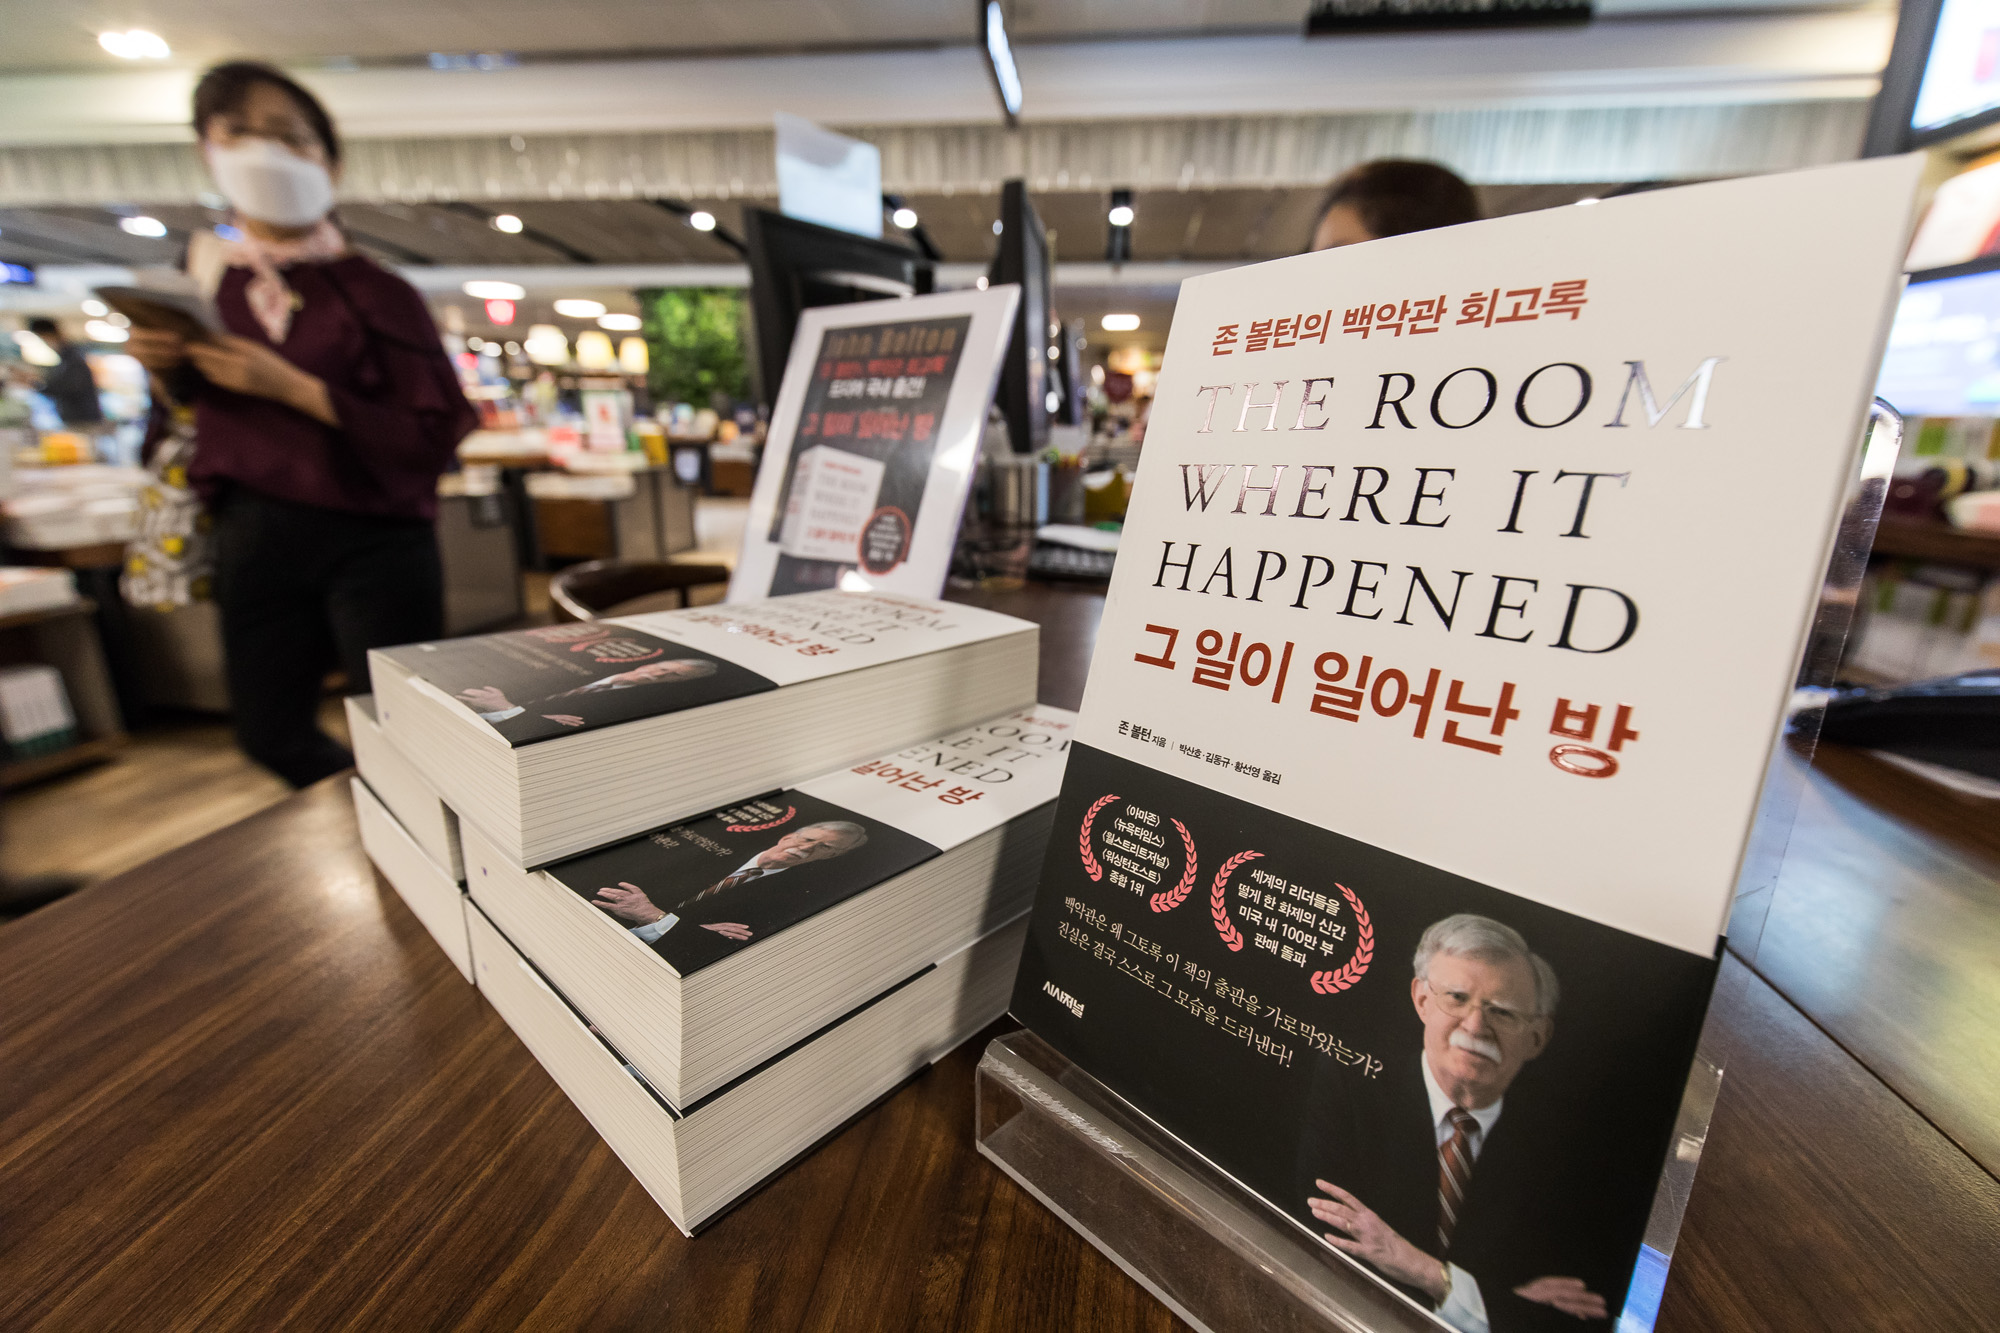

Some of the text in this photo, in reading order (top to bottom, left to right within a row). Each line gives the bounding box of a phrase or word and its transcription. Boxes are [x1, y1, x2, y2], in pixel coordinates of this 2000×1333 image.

[1212, 278, 1589, 356] 존 볼턴의 백악관 회고록
[1196, 356, 1731, 434] THE ROOM
[1178, 464, 1632, 539] WHERE IT
[1152, 541, 1641, 655] HAPPENED
[1134, 623, 1640, 779] 그 일이 일어난 방
[1118, 720, 1129, 735] 존
[1131, 724, 1152, 743] 볼턴
[1152, 735, 1167, 748] 지음
[1262, 769, 1282, 785] 옮김
[937, 785, 986, 805] 방
[1109, 869, 1145, 897] 종합 1위
[1238, 883, 1347, 941] 떨게 한 화제의 신간
[1250, 869, 1340, 916] 세계의 리더들을
[1064, 896, 1107, 932] 백악관은
[1109, 922, 1123, 941] 왜
[1123, 930, 1163, 963] 그토록
[1166, 953, 1180, 972] 이
[1182, 961, 1211, 990] 책의
[1214, 977, 1261, 1016] 출판을
[1238, 905, 1334, 957] 미국 내 100만 부
[1254, 932, 1307, 968] 판매 돌파
[1058, 921, 1294, 1068] 진실은 결국 스스로 그 모습을 드러낸다!
